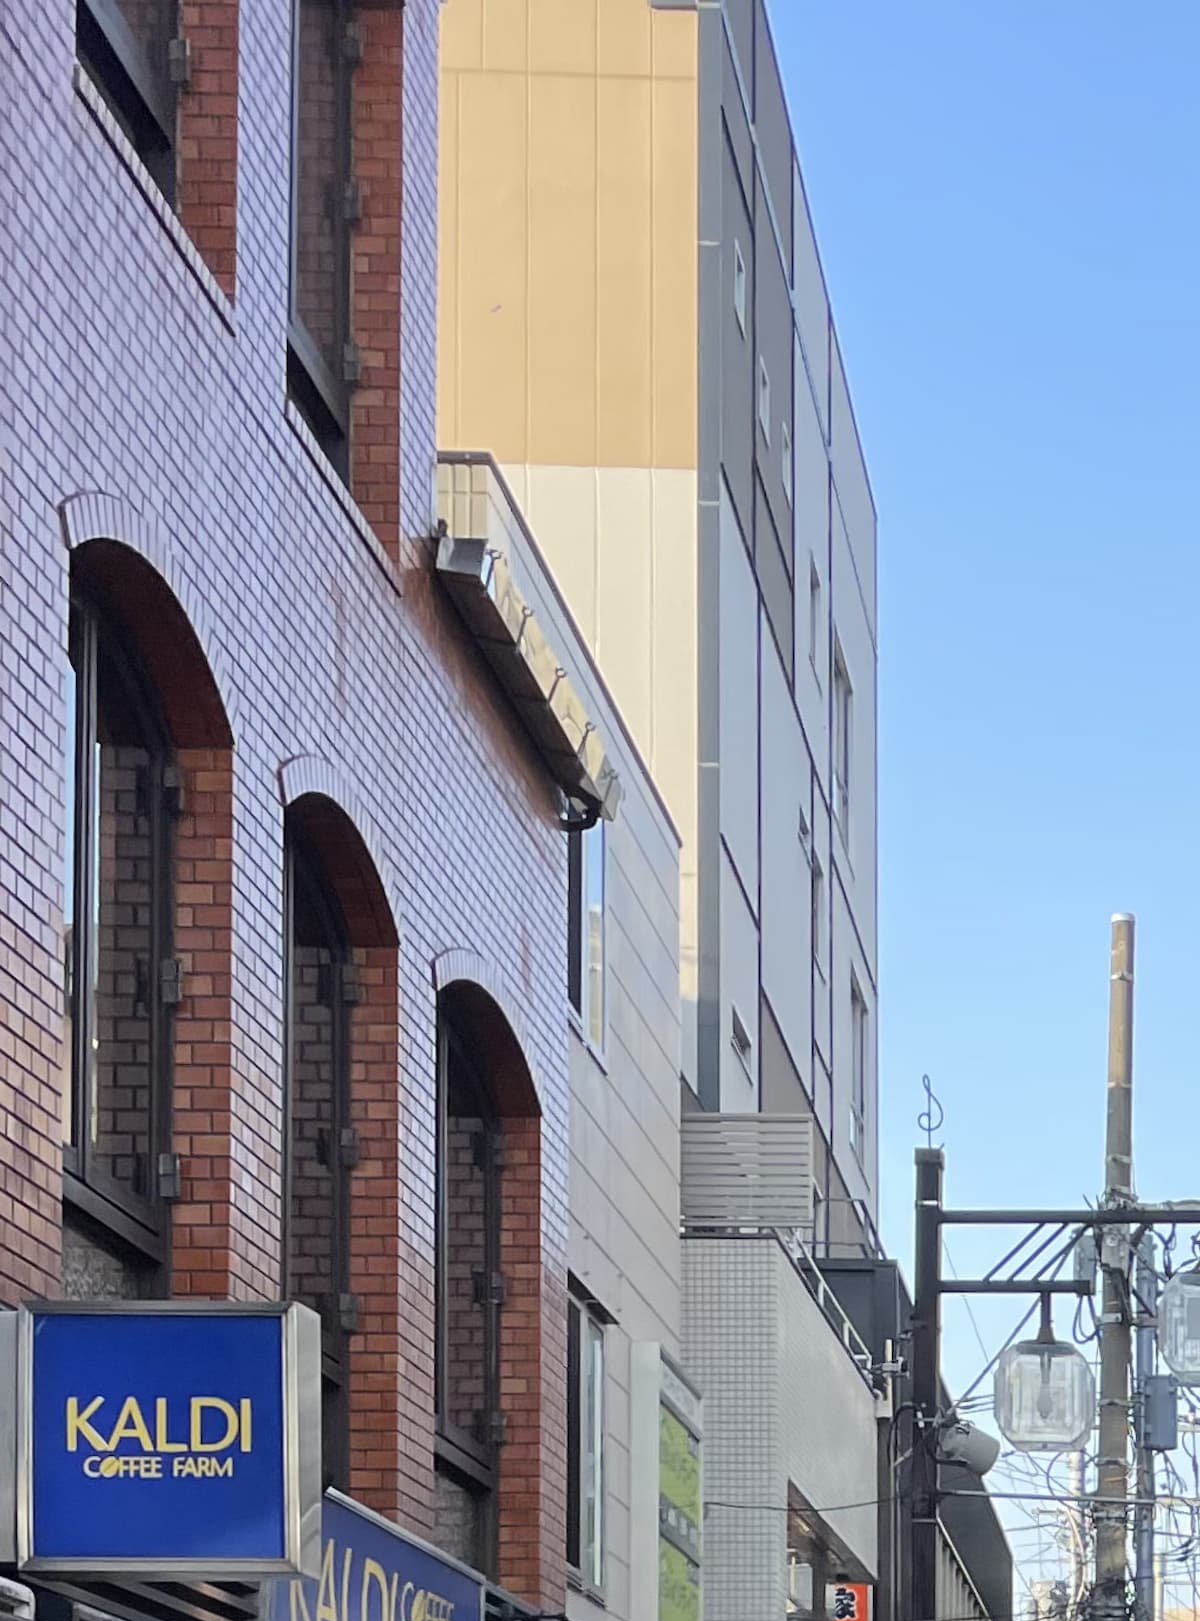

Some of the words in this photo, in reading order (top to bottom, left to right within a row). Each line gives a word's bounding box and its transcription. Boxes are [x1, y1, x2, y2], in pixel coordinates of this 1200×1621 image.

[66, 1396, 251, 1452] KALDI
[83, 1455, 163, 1478] COFFEE
[173, 1456, 233, 1478] FARM
